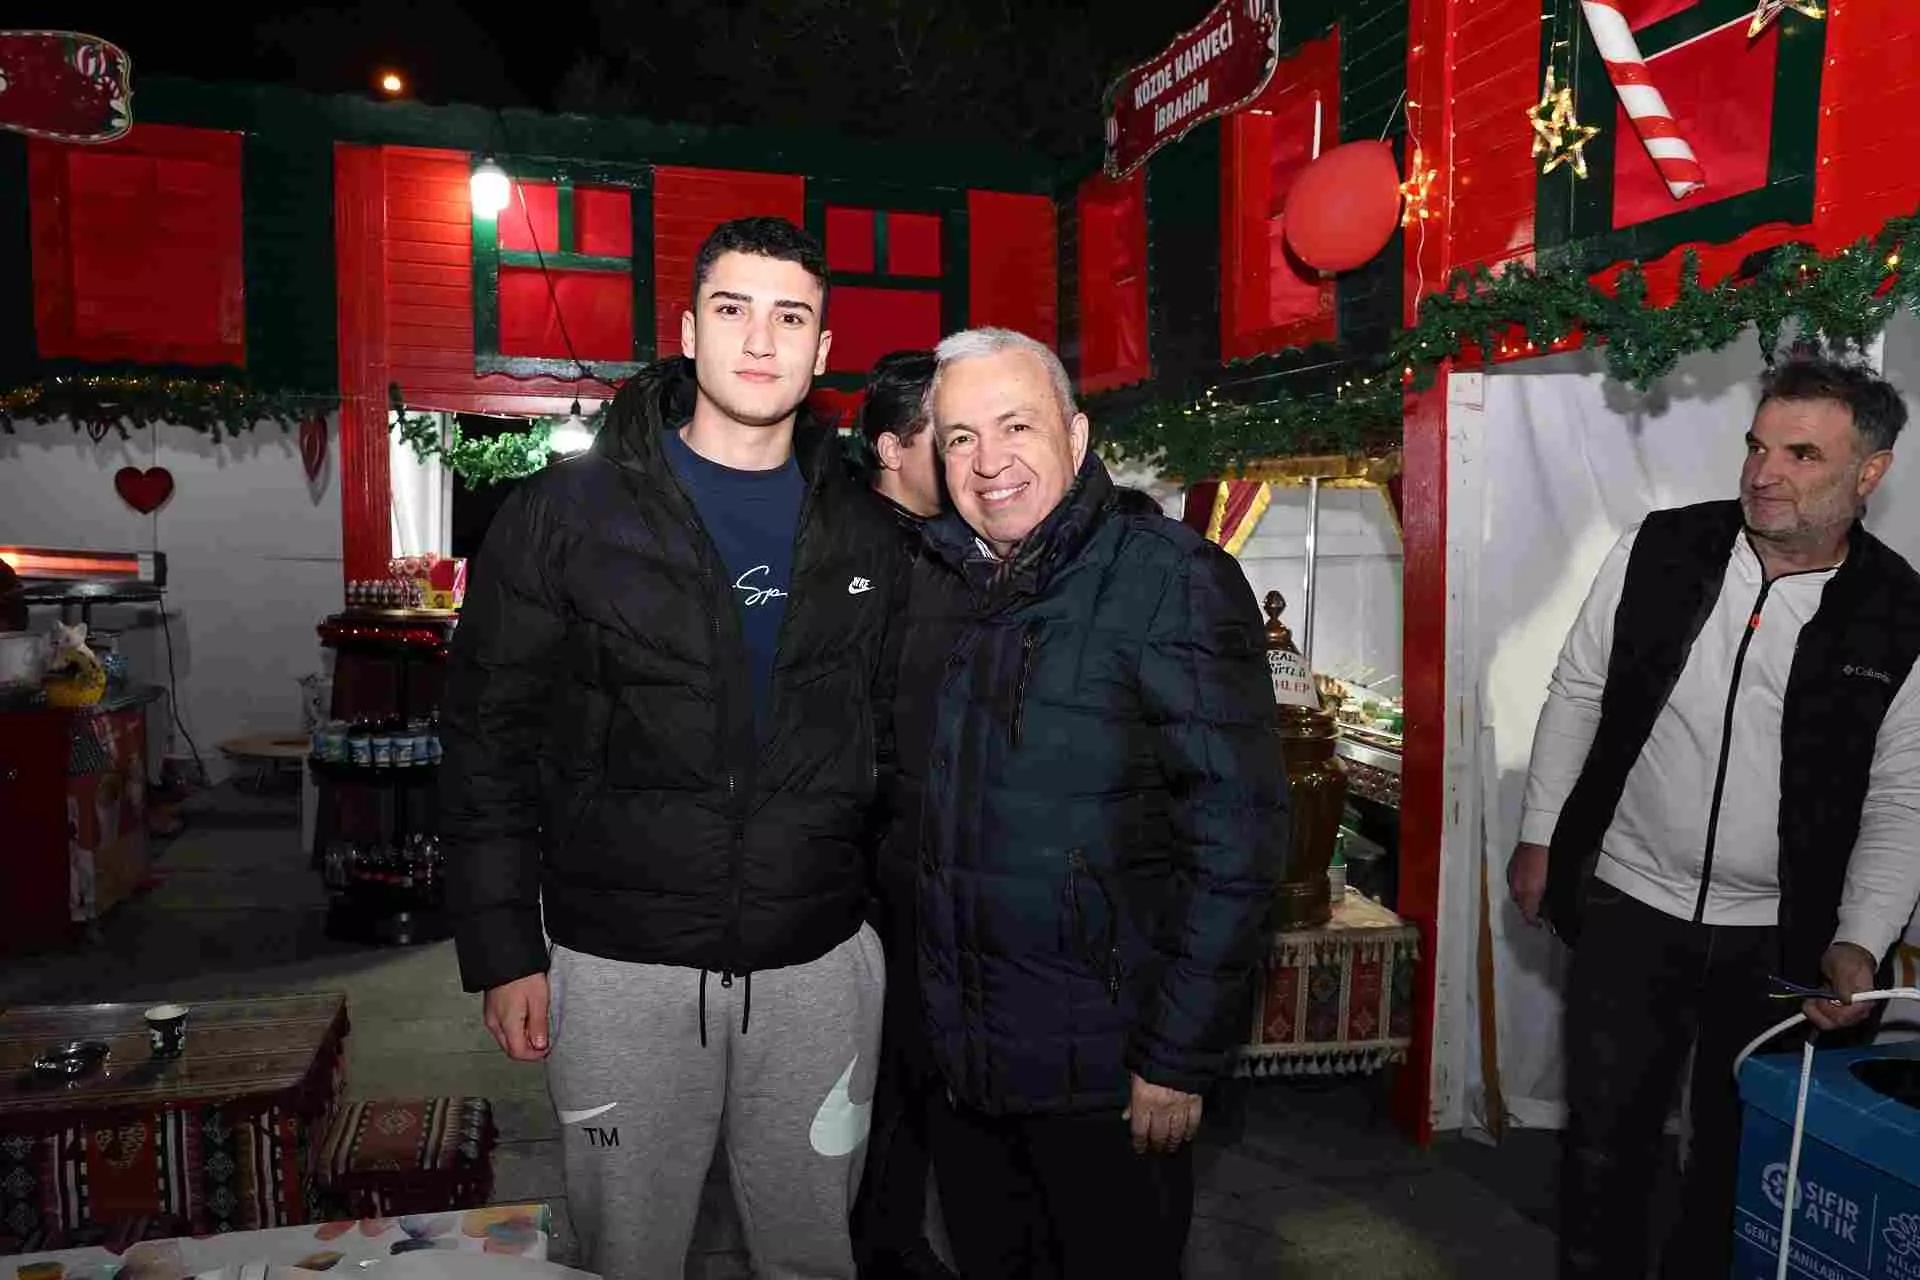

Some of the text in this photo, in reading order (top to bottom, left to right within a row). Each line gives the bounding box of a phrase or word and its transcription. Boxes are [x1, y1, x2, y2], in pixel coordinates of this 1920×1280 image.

[1133, 10, 1233, 110] KÖZDE KAHVECİ
[1154, 77, 1209, 135] İBRAHİM
[583, 1127, 620, 1148] TM
[1804, 1181, 1859, 1224] SIFIR
[1804, 1203, 1858, 1245] ATIK
